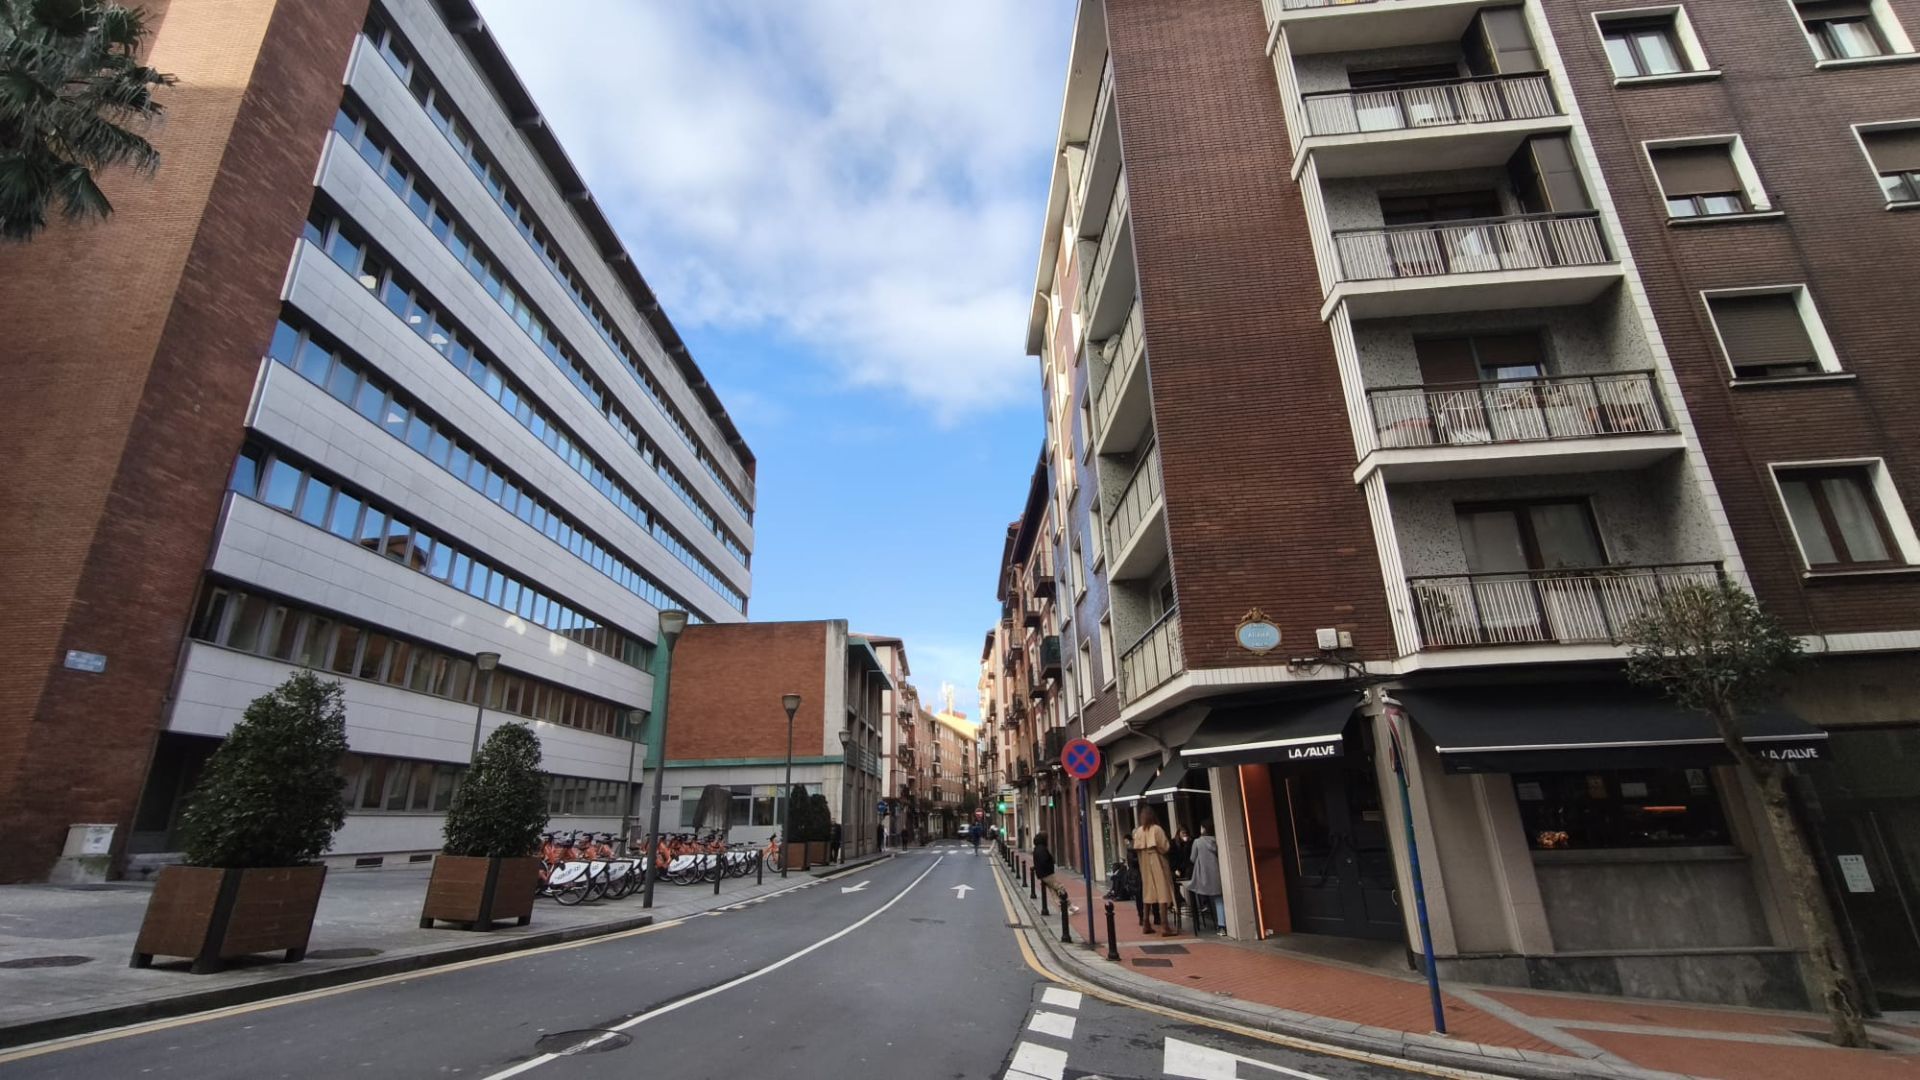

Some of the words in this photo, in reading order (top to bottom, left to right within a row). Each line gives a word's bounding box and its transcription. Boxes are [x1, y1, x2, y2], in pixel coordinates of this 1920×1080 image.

[1288, 748, 1303, 759] LA
[1303, 745, 1335, 758] SALVE
[1781, 748, 1819, 760] SALVE
